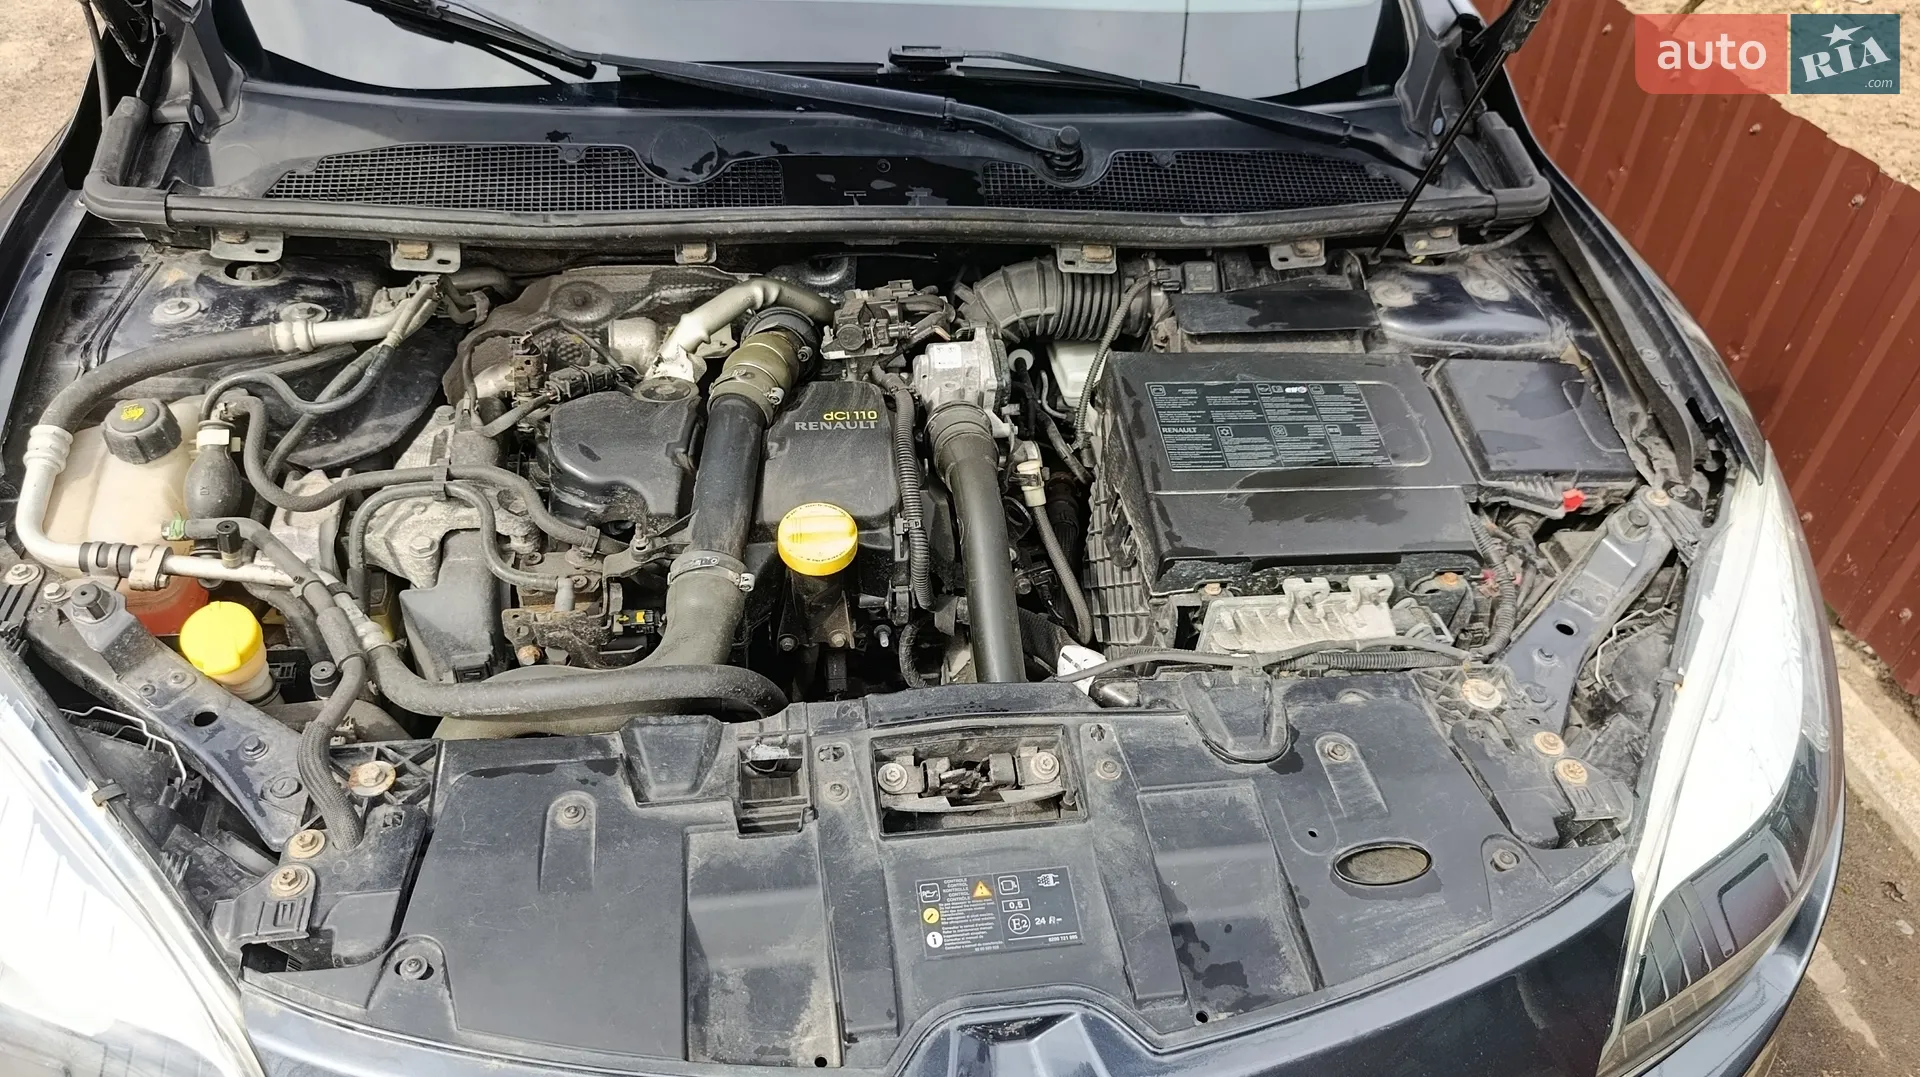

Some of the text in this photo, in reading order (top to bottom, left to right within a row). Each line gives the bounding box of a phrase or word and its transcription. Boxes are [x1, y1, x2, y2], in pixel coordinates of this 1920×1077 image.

[823, 410, 878, 420] dCi 110
[794, 420, 878, 430] RENAULT
[1009, 901, 1023, 910] 0,5
[1011, 918, 1028, 931] E2
[1035, 917, 1046, 925] 24
